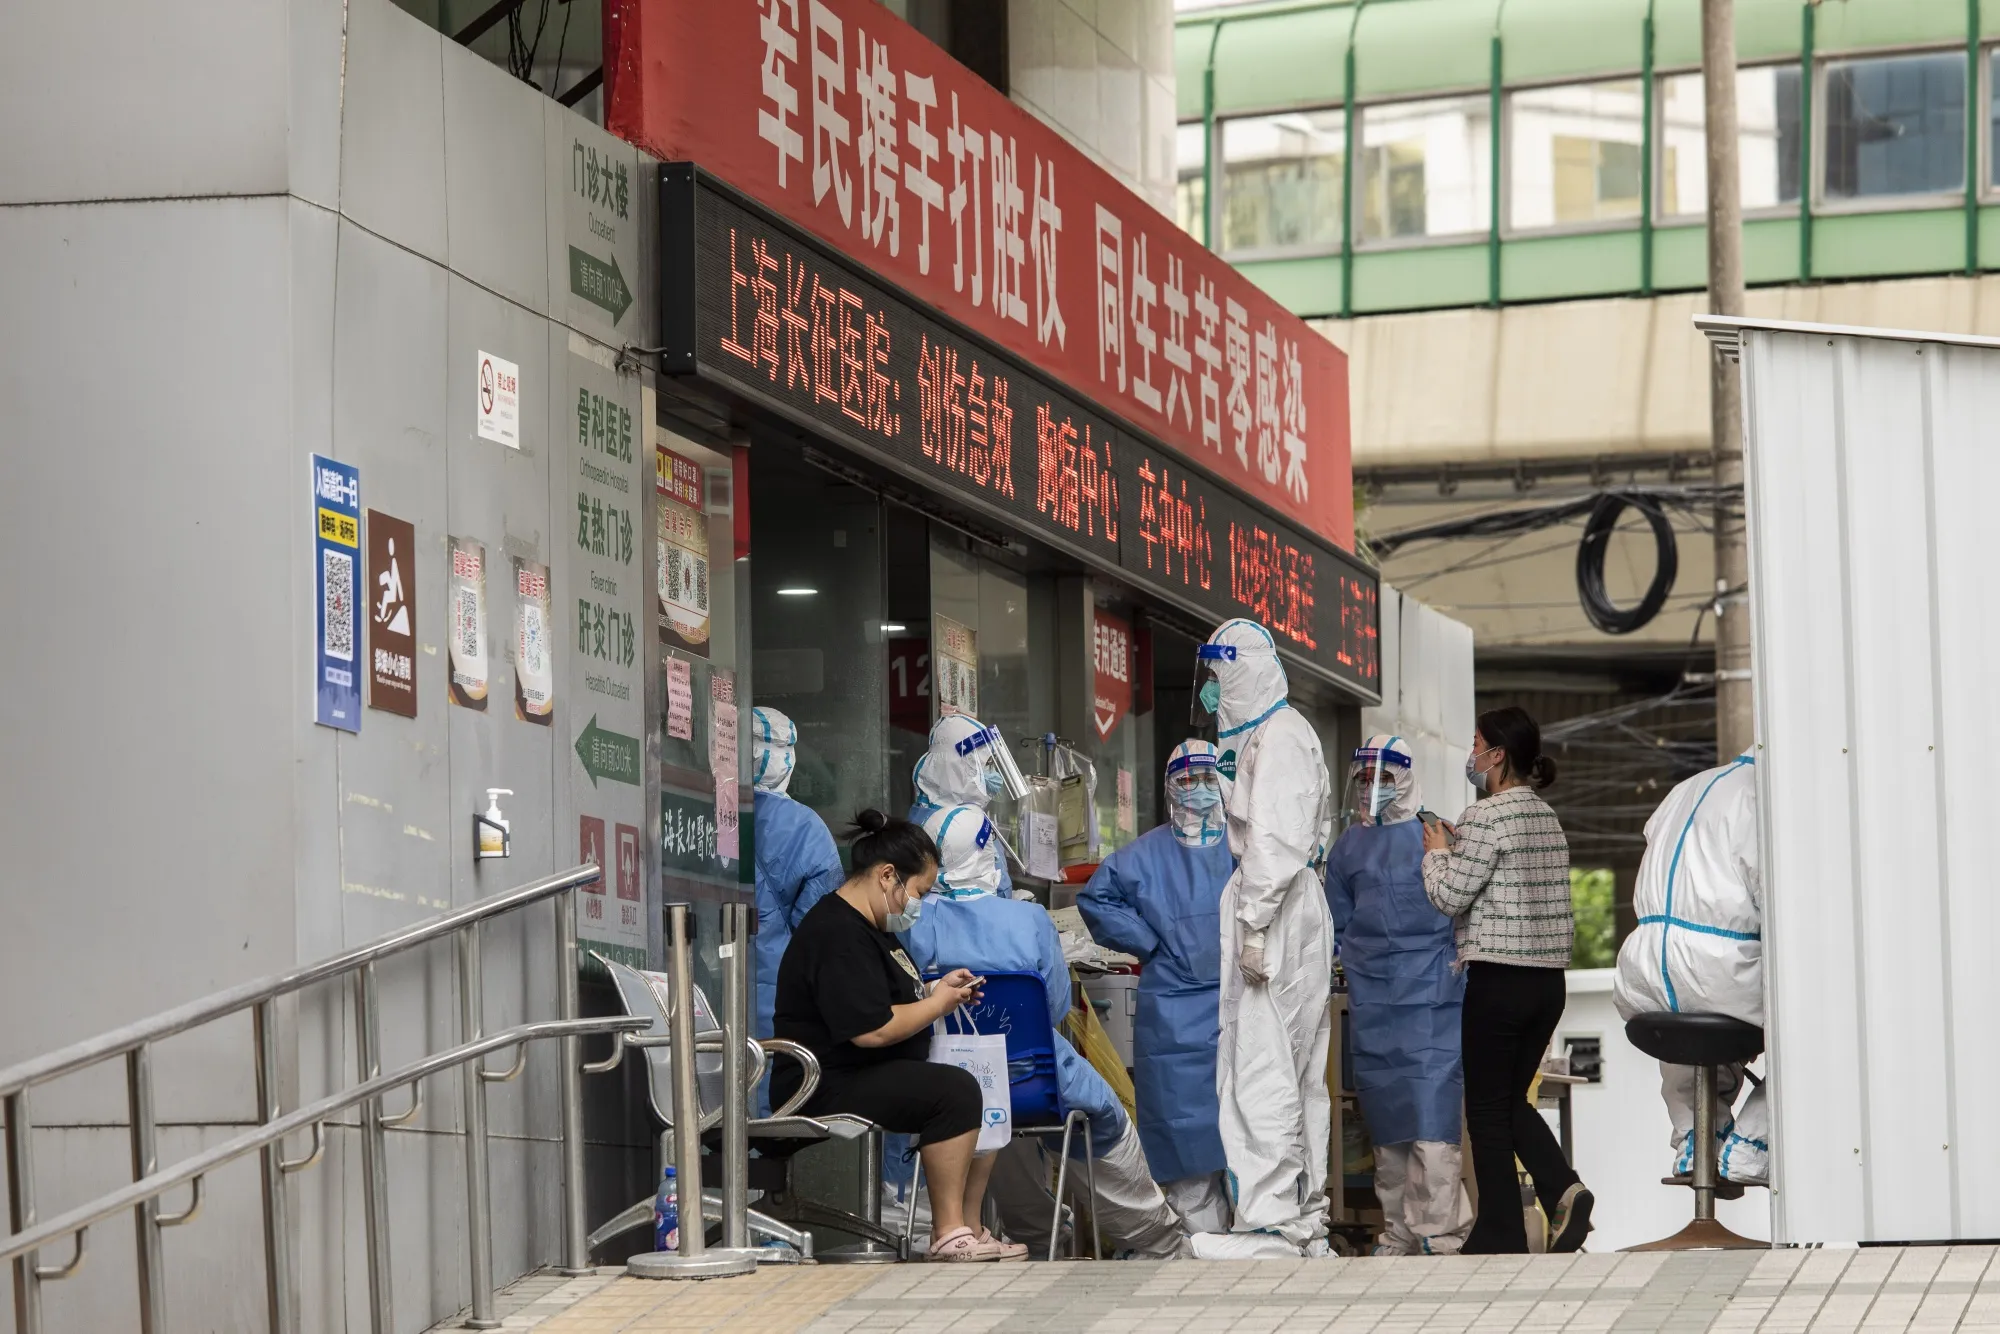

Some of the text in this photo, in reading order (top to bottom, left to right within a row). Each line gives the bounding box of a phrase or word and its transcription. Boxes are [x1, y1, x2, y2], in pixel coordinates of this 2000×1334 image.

[572, 137, 629, 221] 门诊大楼
[588, 211, 616, 245] Outpatient
[757, 0, 1309, 503] 军民携手打胜仗 同生共苦零感染
[579, 259, 624, 310] 请向前100米
[577, 388, 632, 464] 骨科医院
[580, 458, 610, 487] Orthopaedic
[611, 470, 629, 494] Hospital
[917, 332, 1015, 500] 创伤急救
[1036, 400, 1120, 543] 胸痛中心
[1138, 458, 1212, 591] 卒中中心
[577, 492, 633, 565] 发热门诊
[591, 570, 617, 597] Fever clinic
[578, 598, 635, 668] 肝炎门诊
[584, 671, 630, 702] Hepatitis Outpatient
[592, 738, 631, 785] 请向前30米
